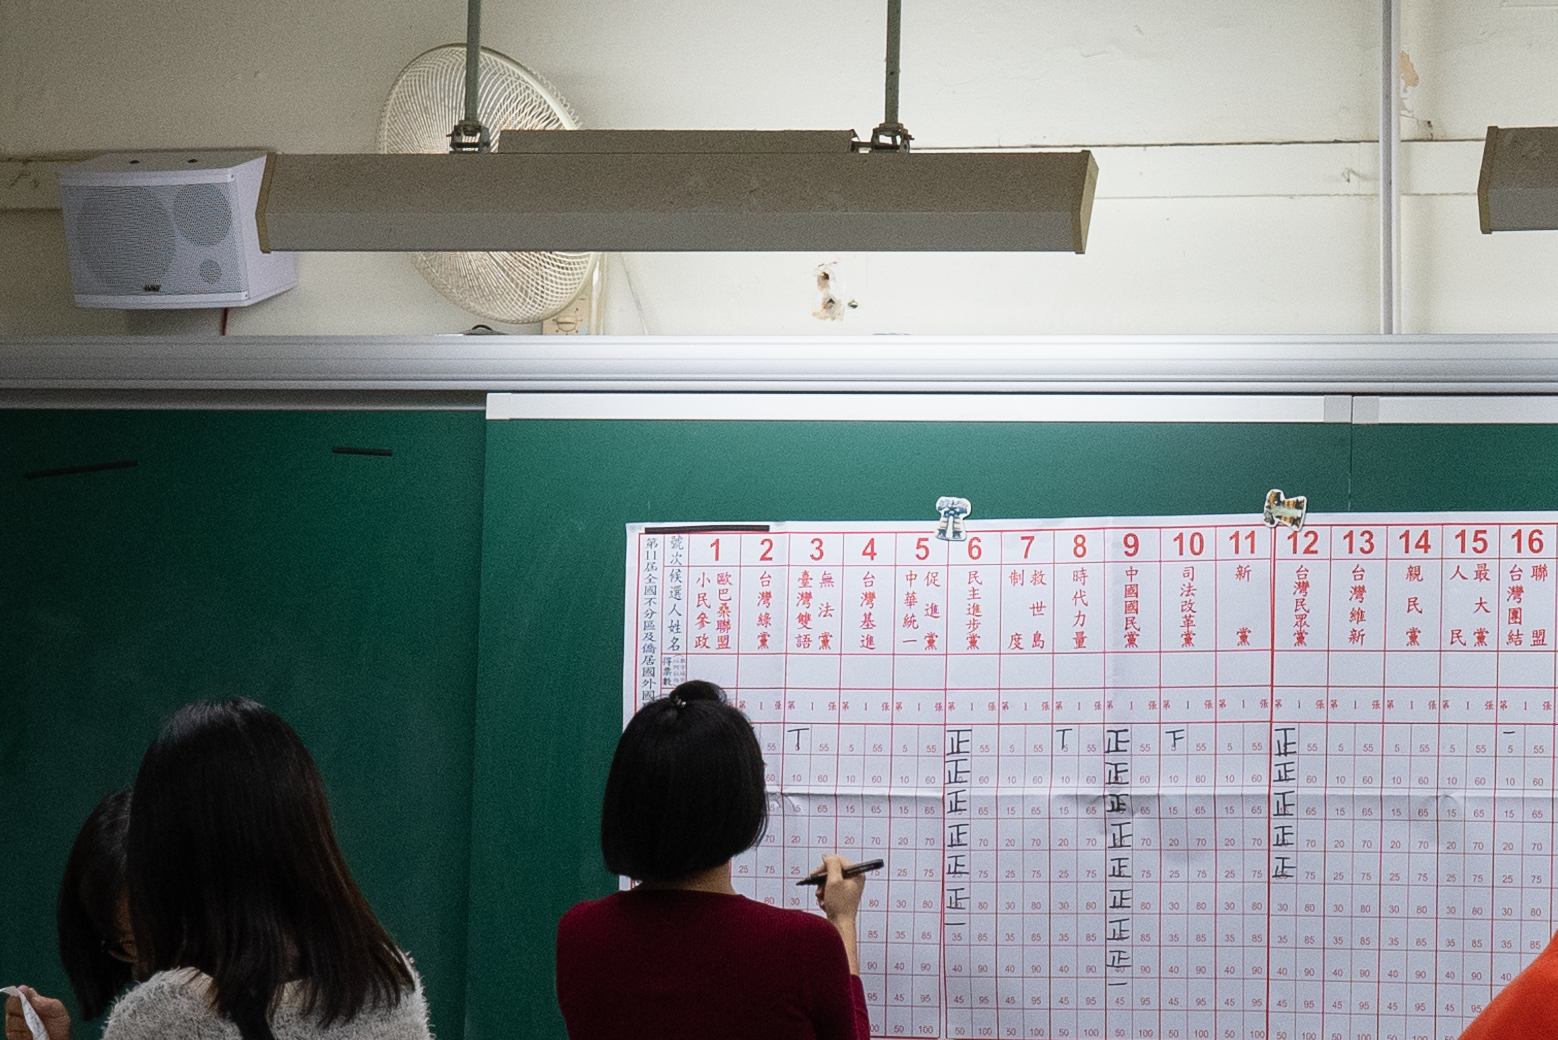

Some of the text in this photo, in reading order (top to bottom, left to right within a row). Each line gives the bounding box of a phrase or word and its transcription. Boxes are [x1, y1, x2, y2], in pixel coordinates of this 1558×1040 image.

[670, 535, 684, 566] 號次
[710, 539, 719, 561] 1
[760, 538, 773, 561] 2
[810, 538, 824, 561] 3
[862, 538, 877, 561] 4
[915, 538, 929, 560] 5
[968, 537, 982, 560] 6
[1021, 536, 1035, 559] 7
[1073, 534, 1086, 558] 8
[1123, 533, 1139, 557] 9
[1173, 532, 1204, 556] 10
[1229, 530, 1255, 554] 11
[1287, 530, 1318, 554] 12
[1343, 530, 1374, 554] 13
[1399, 530, 1431, 554] 14
[1455, 529, 1488, 554] 15
[1511, 529, 1543, 553] 16
[668, 568, 683, 651] 候選人姓名
[695, 572, 711, 649] 小民參政
[716, 572, 732, 649] 歐巴桑聯盟
[757, 571, 772, 649] 台灣綠黨
[795, 571, 813, 648] 臺灣雙語
[818, 571, 835, 650] 無法黨
[860, 571, 876, 649] 台灣基進
[902, 571, 919, 644] 中華統一
[924, 571, 941, 651] 促進黨
[966, 570, 982, 651] 民主進步黨
[1030, 569, 1046, 649] 救世島
[1071, 567, 1088, 649] 時代力量
[1123, 566, 1140, 648] 中國國民黨
[1180, 566, 1197, 647] 司法改革黨
[1293, 565, 1310, 647] 台灣民眾黨
[1348, 565, 1366, 645] 台灣維新
[1405, 565, 1423, 646] 親民黨
[1473, 564, 1491, 647] 最大黨
[1506, 565, 1524, 645] 台灣團結
[641, 538, 658, 706] 第11屆全國不分區及僑居國外國
[1228, 743, 1232, 751] 5
[1252, 743, 1262, 751] 55
[1363, 744, 1373, 752] 55
[1226, 775, 1234, 783] 10
[1336, 776, 1346, 784] 10
[1362, 776, 1373, 784] 60
[1225, 806, 1234, 814] 15
[1251, 806, 1262, 814] 65
[1336, 808, 1345, 816] 15
[1362, 808, 1372, 816] 65
[1225, 838, 1235, 846] 20
[1253, 838, 1262, 846] 70
[1334, 840, 1344, 848] 20
[1363, 840, 1372, 848] 70
[1225, 870, 1235, 878] 25
[1253, 870, 1262, 878] 75
[1334, 872, 1344, 880] 25
[1225, 902, 1235, 910] 30
[1252, 902, 1262, 910] 80
[1334, 904, 1343, 912] 30
[1361, 905, 1370, 913] 80
[1225, 934, 1235, 942] 35
[1252, 934, 1262, 942] 85
[1334, 936, 1343, 945] 35
[1360, 937, 1370, 945] 85
[1224, 966, 1235, 974] 40
[1252, 966, 1262, 974] 90
[1333, 969, 1343, 977] 40
[1360, 969, 1370, 977] 90
[1225, 998, 1235, 1006] 45
[1332, 1001, 1342, 1009] 45
[1359, 1002, 1369, 1010] 95
[1225, 1030, 1235, 1038] 50
[1332, 1033, 1342, 1040] 50
